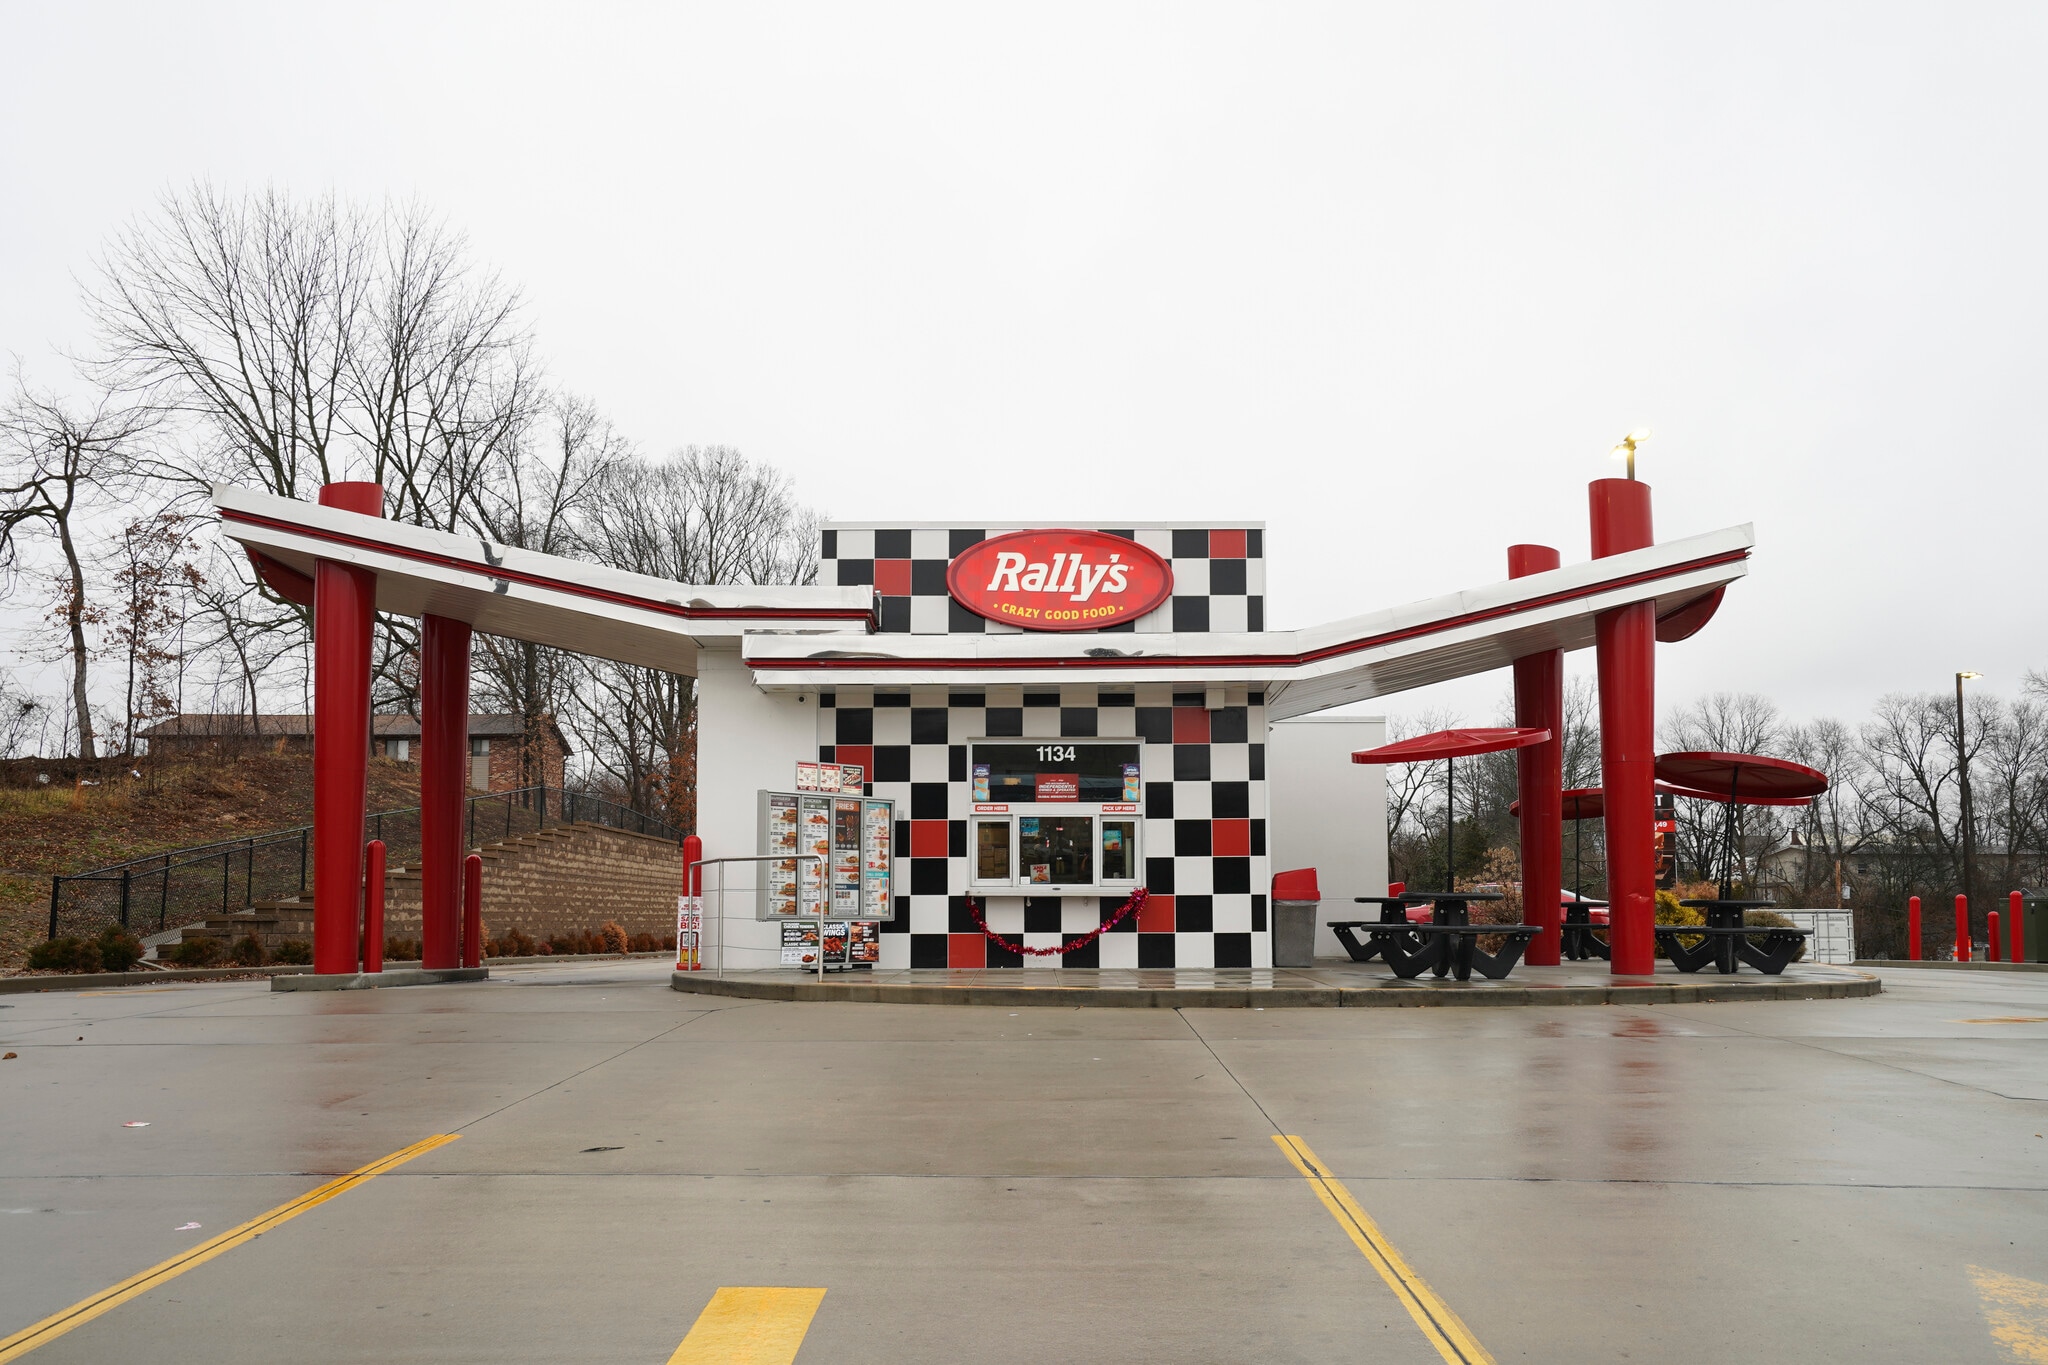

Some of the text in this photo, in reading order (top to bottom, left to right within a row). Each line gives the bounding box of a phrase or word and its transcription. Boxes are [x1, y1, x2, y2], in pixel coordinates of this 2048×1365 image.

[987, 552, 1129, 602] Rally's
[1001, 603, 1116, 620] CRAZY GOOD FOOD
[1036, 746, 1076, 762] 1134
[836, 802, 855, 810] FRIES
